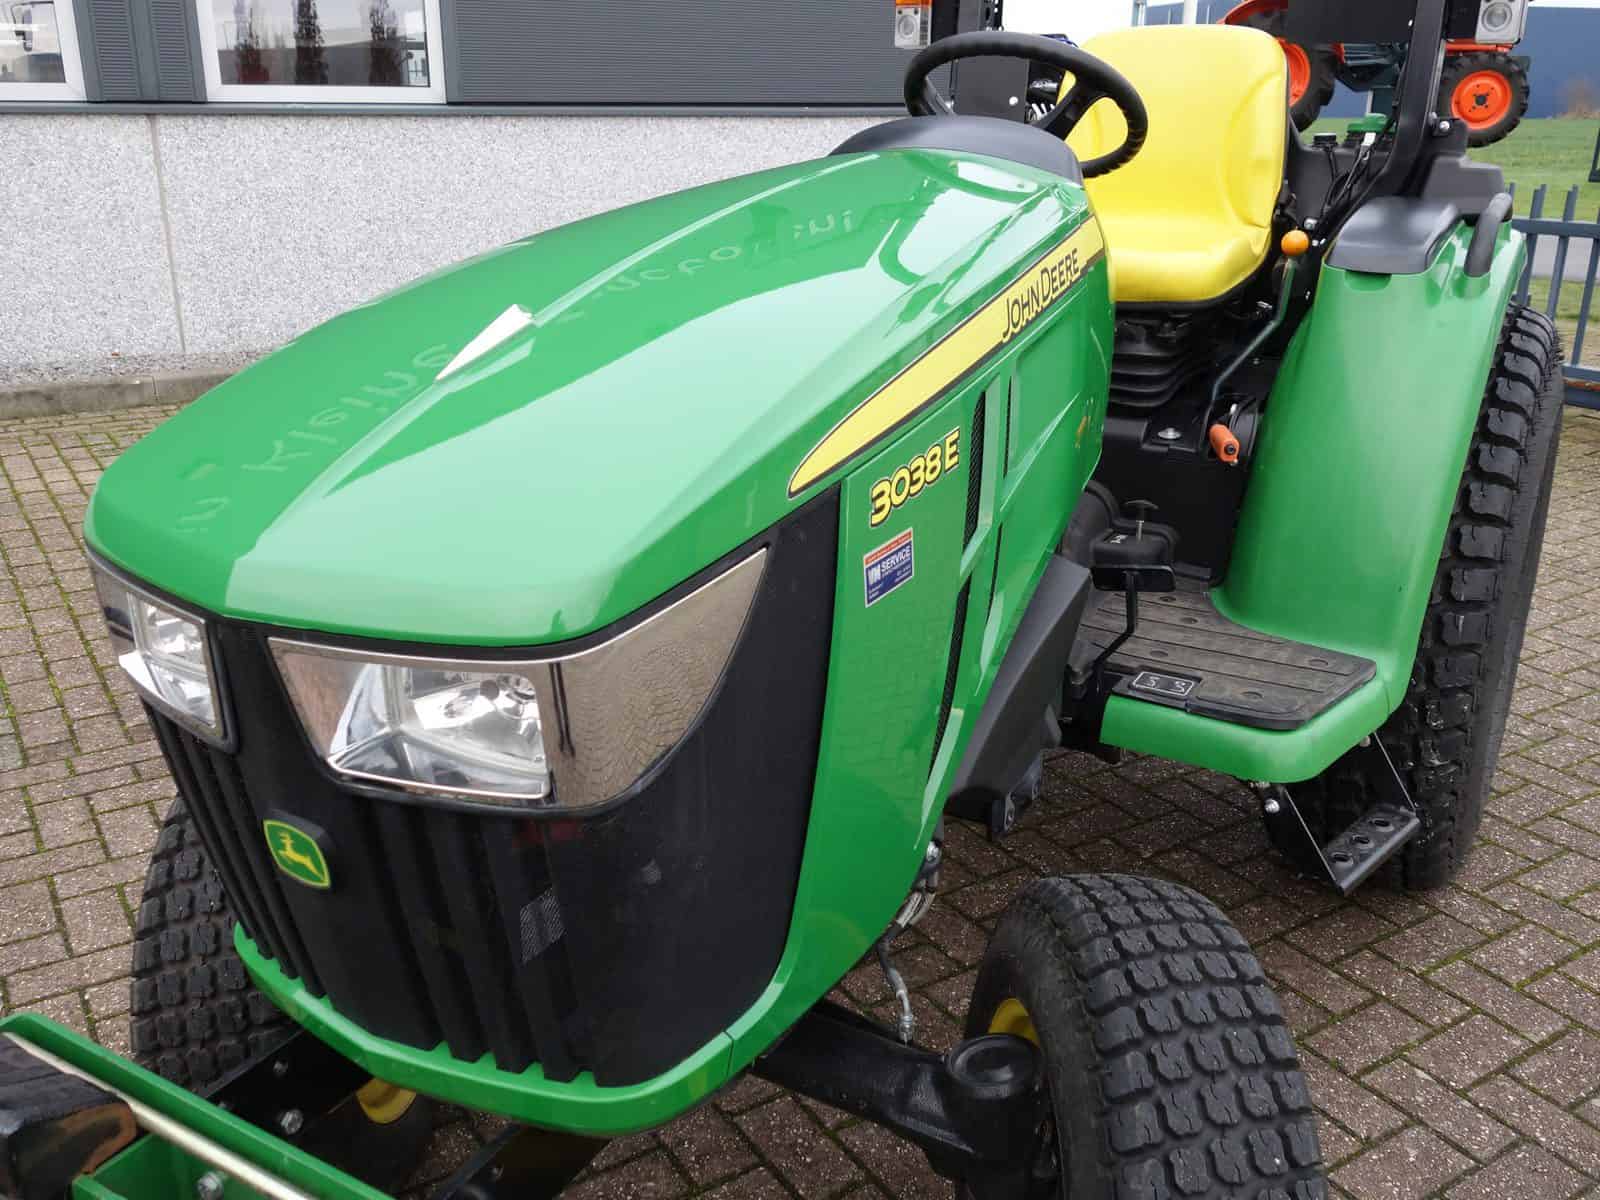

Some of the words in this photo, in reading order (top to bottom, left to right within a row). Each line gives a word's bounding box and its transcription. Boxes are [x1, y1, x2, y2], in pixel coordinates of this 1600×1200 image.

[1002, 279, 1043, 338] JOHN
[1040, 247, 1080, 303] DEERE
[880, 545, 911, 573] SERVICE
